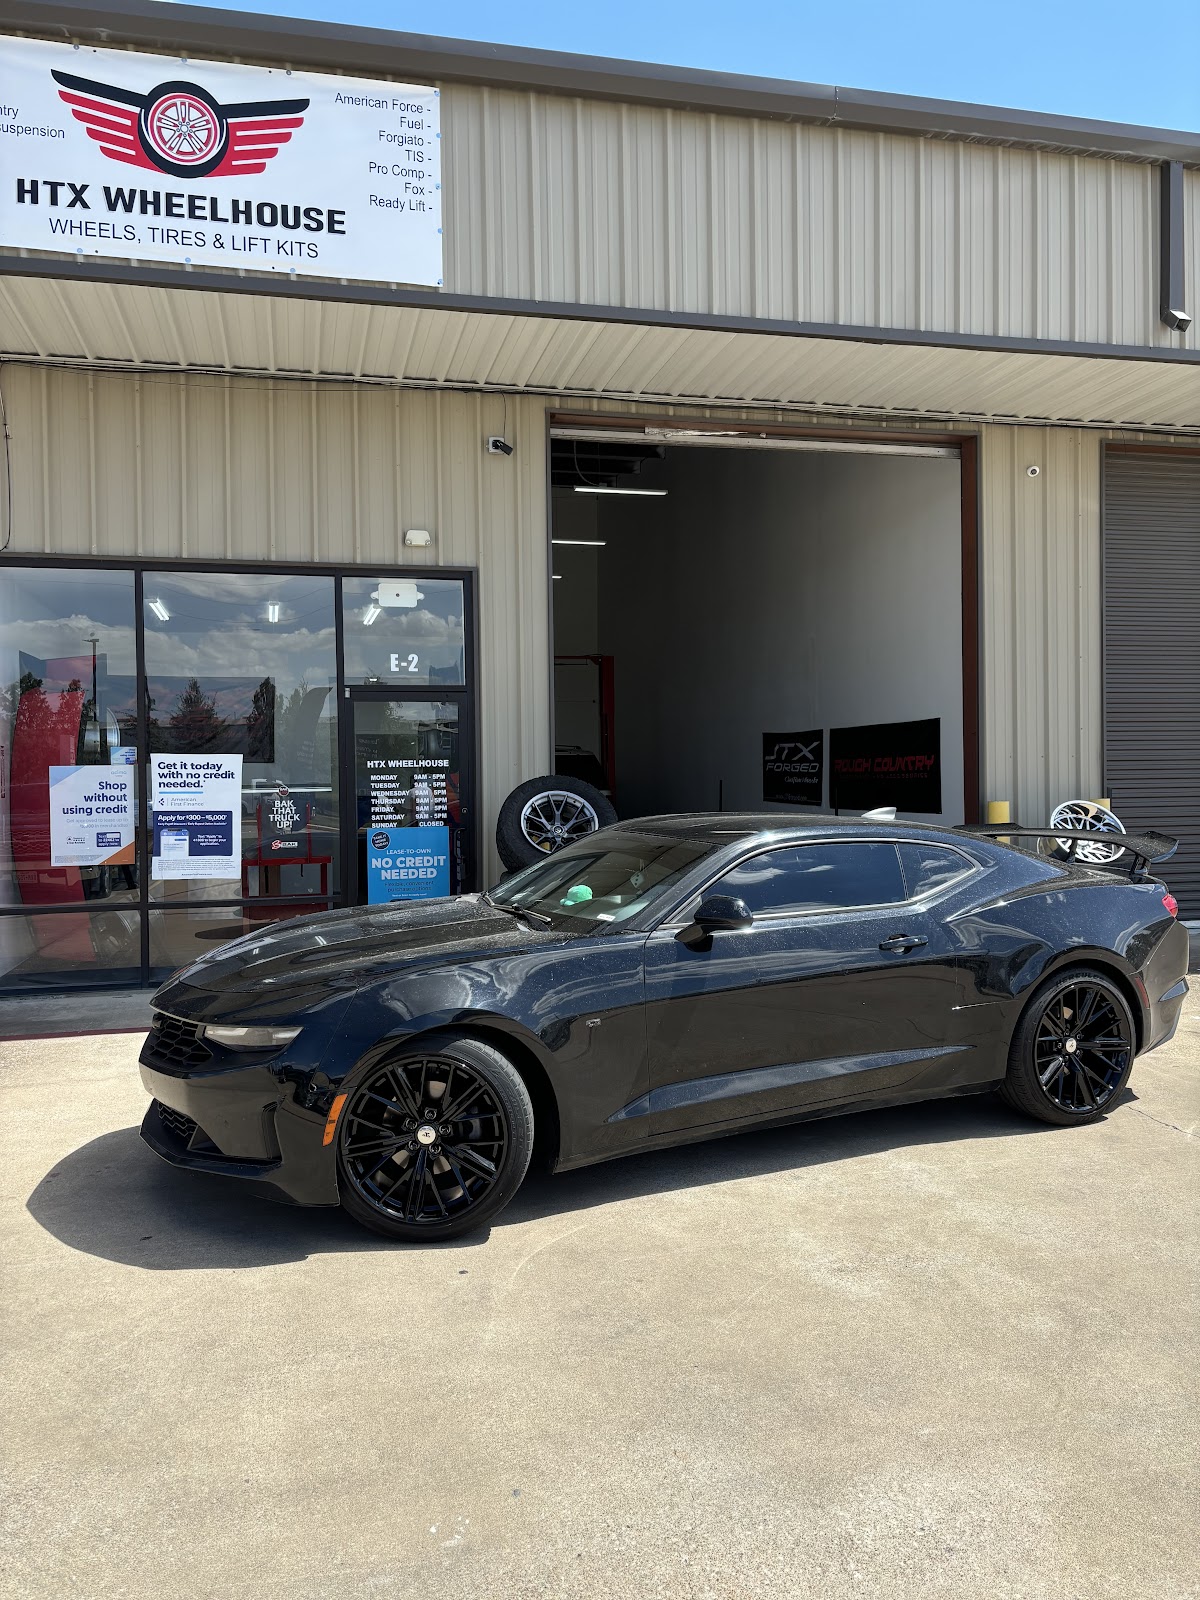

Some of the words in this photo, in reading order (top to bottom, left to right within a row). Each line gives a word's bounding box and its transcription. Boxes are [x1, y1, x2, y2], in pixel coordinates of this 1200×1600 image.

[334, 92, 388, 109] American
[391, 98, 423, 114] Force
[0, 122, 65, 139] uspension
[399, 116, 424, 131] Fuel
[378, 130, 424, 148] Forgiato
[405, 149, 424, 163] TIS
[368, 161, 389, 175] Pro
[391, 164, 425, 182] Comp
[404, 182, 425, 197] Fox
[16, 177, 91, 209] HTX
[102, 185, 347, 235] WHEELHOUSE
[368, 195, 405, 213] Ready
[408, 198, 426, 213] Lift
[49, 217, 142, 245] WHEELS,
[147, 226, 206, 248] TIRES
[212, 233, 226, 250] &
[231, 235, 271, 253] LIFT
[277, 239, 319, 259] KITS
[390, 653, 419, 672] E-2
[765, 741, 821, 760] JTX
[158, 761, 178, 770] Get
[180, 761, 188, 770] it
[190, 762, 223, 772] today
[367, 760, 386, 769] HTX
[387, 759, 450, 768] WHEELHOUSE
[766, 763, 819, 772] FORGED
[833, 758, 871, 772] ROUGH
[873, 755, 935, 772] COUNTRY
[158, 770, 183, 779] with
[203, 771, 236, 780] credit
[98, 781, 127, 791] Shop
[84, 793, 127, 802] without
[62, 806, 93, 816] using
[95, 804, 128, 814] credit
[158, 814, 177, 822] Apply
[268, 814, 300, 822] TRUCK
[372, 858, 392, 868] NO
[396, 856, 446, 867] CREDIT
[381, 868, 437, 880] NEEDED
